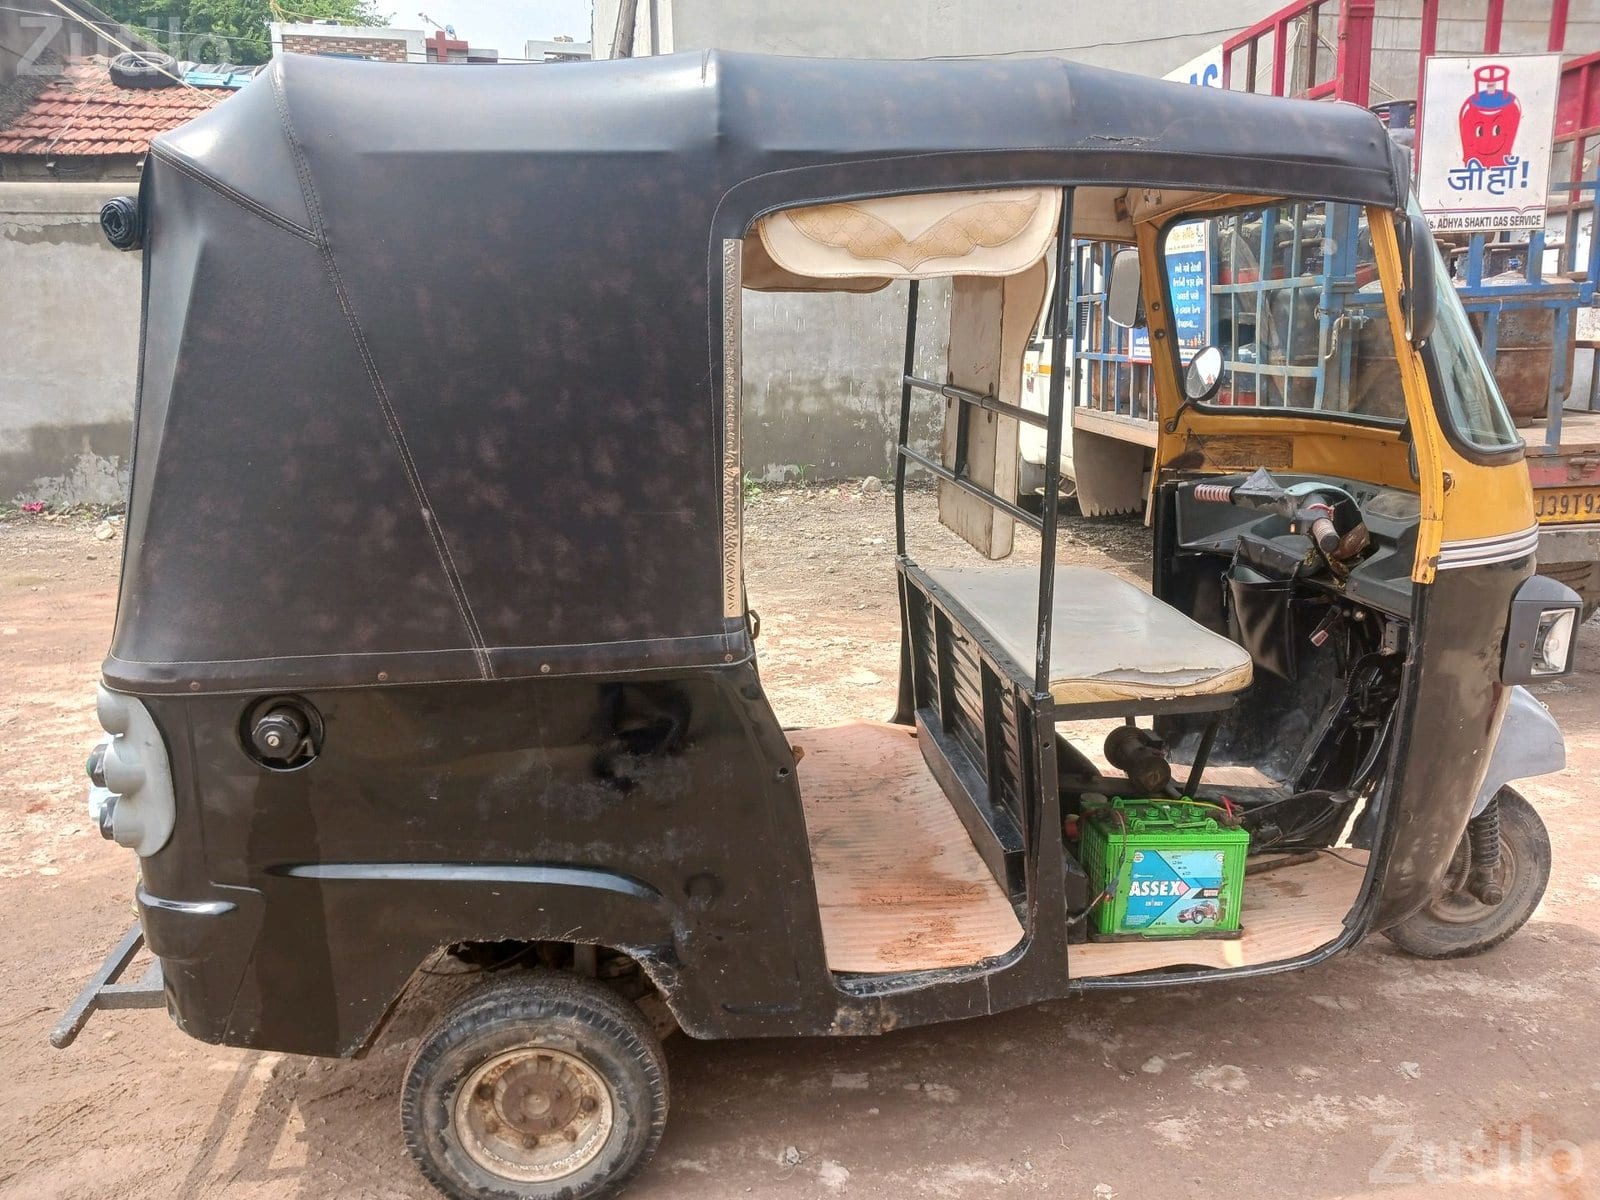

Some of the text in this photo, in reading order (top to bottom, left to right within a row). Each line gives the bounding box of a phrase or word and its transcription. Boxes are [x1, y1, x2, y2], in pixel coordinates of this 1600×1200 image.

[1447, 158, 1487, 190] जी
[1437, 217, 1463, 229] ADHYA
[1464, 216, 1492, 228] SHAKTI
[1493, 216, 1509, 227] GAS
[1509, 214, 1542, 227] SERVICE
[1129, 881, 1181, 896] ASSEX
